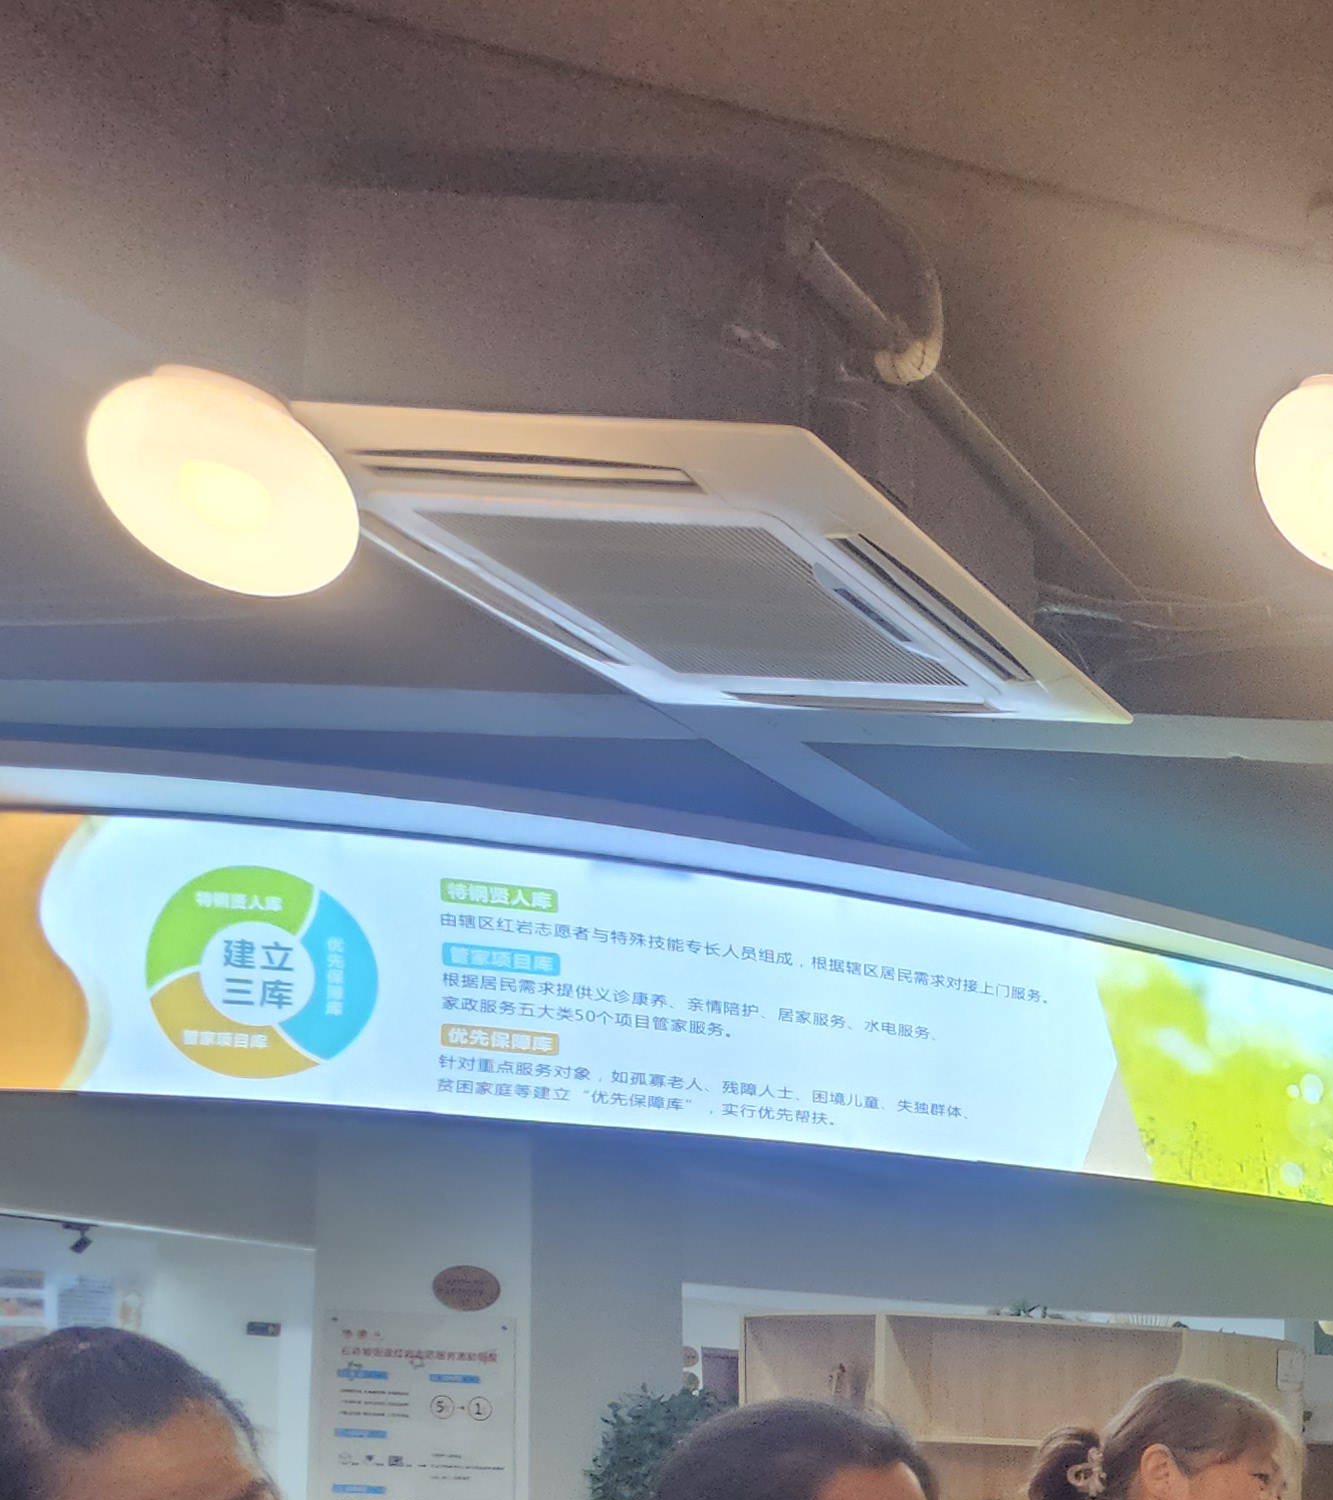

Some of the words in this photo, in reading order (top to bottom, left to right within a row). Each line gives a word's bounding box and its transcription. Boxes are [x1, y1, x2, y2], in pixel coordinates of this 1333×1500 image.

[446, 881, 553, 910] 特钢贤人库
[222, 939, 294, 972] 建立
[222, 977, 294, 1010] 三库
[447, 1026, 555, 1053] 优先保障库
